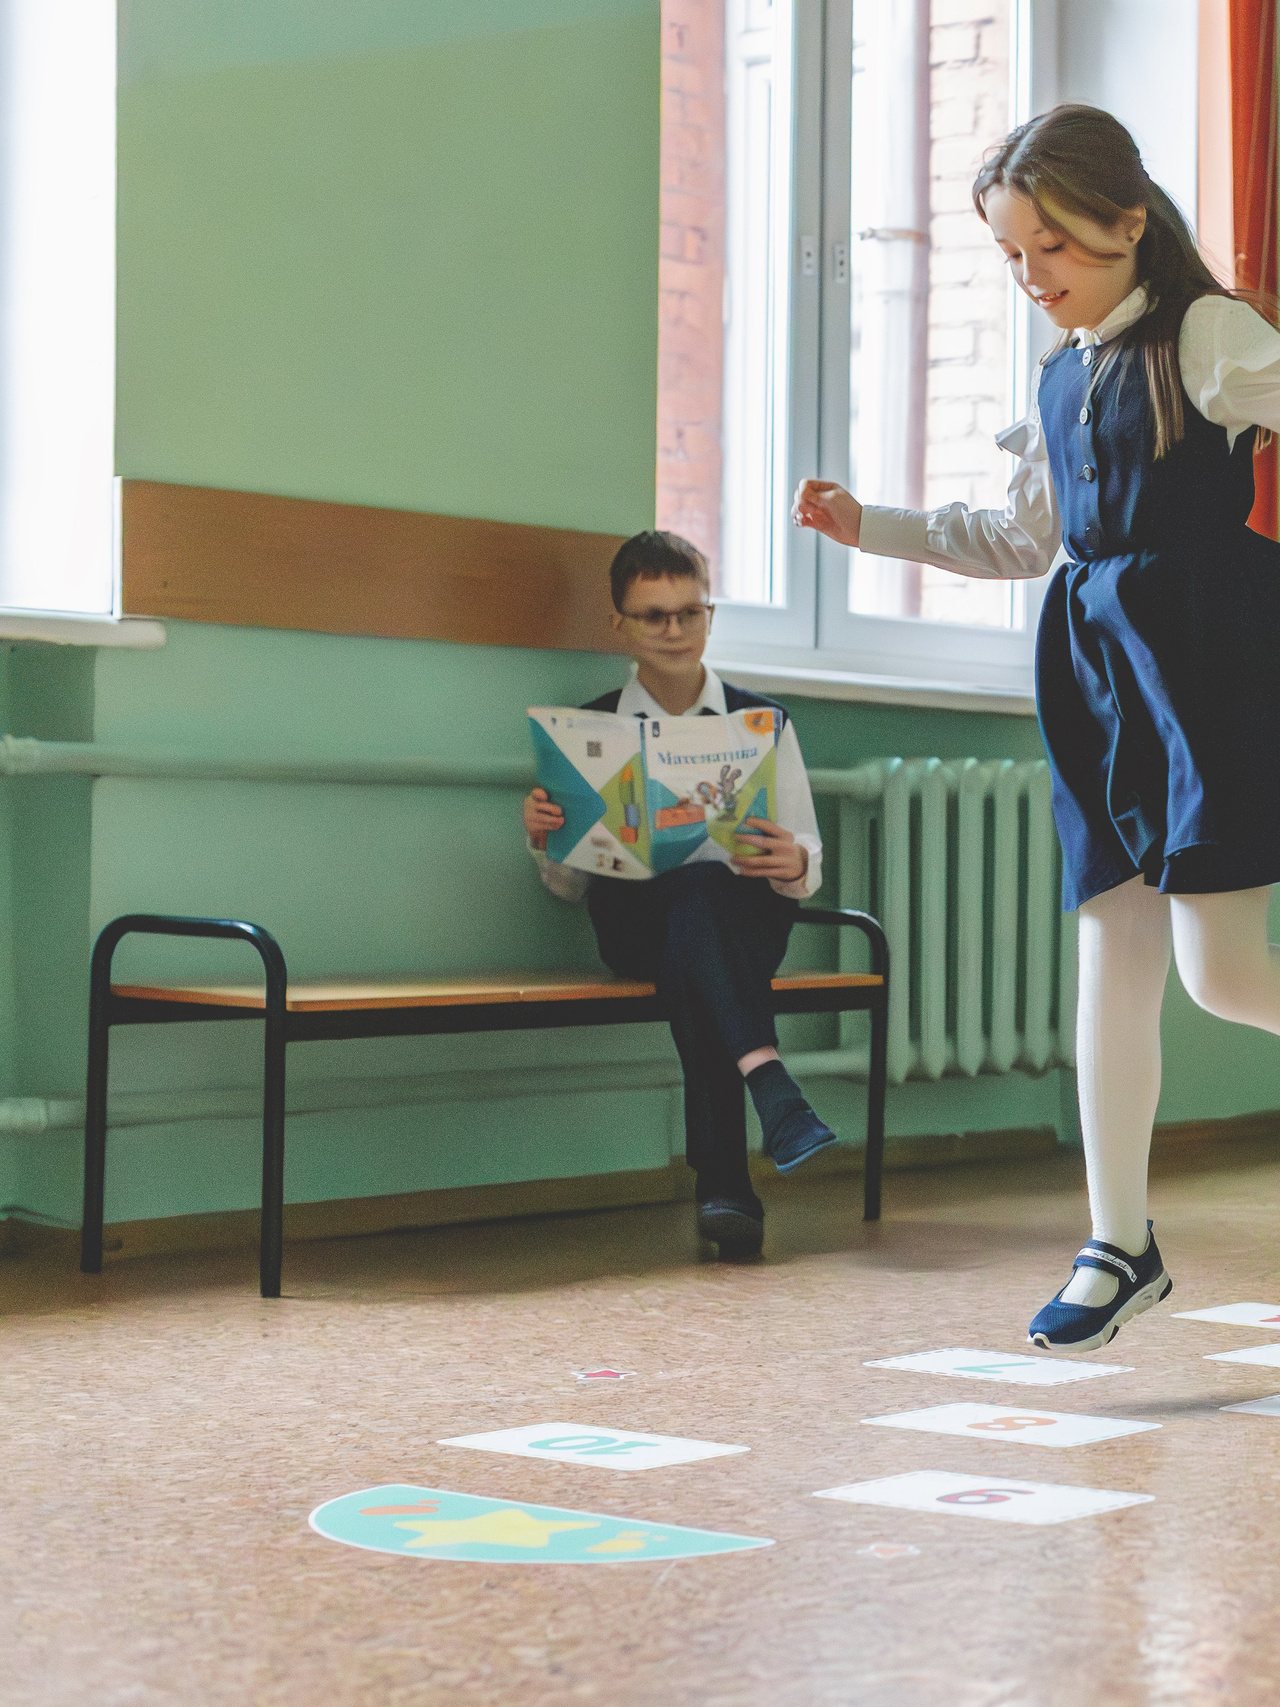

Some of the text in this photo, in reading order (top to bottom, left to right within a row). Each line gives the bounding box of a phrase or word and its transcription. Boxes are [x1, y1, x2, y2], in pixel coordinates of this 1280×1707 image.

[657, 747, 758, 766] Математика
[966, 1416, 1058, 1431] 8
[527, 1435, 661, 1455] 10
